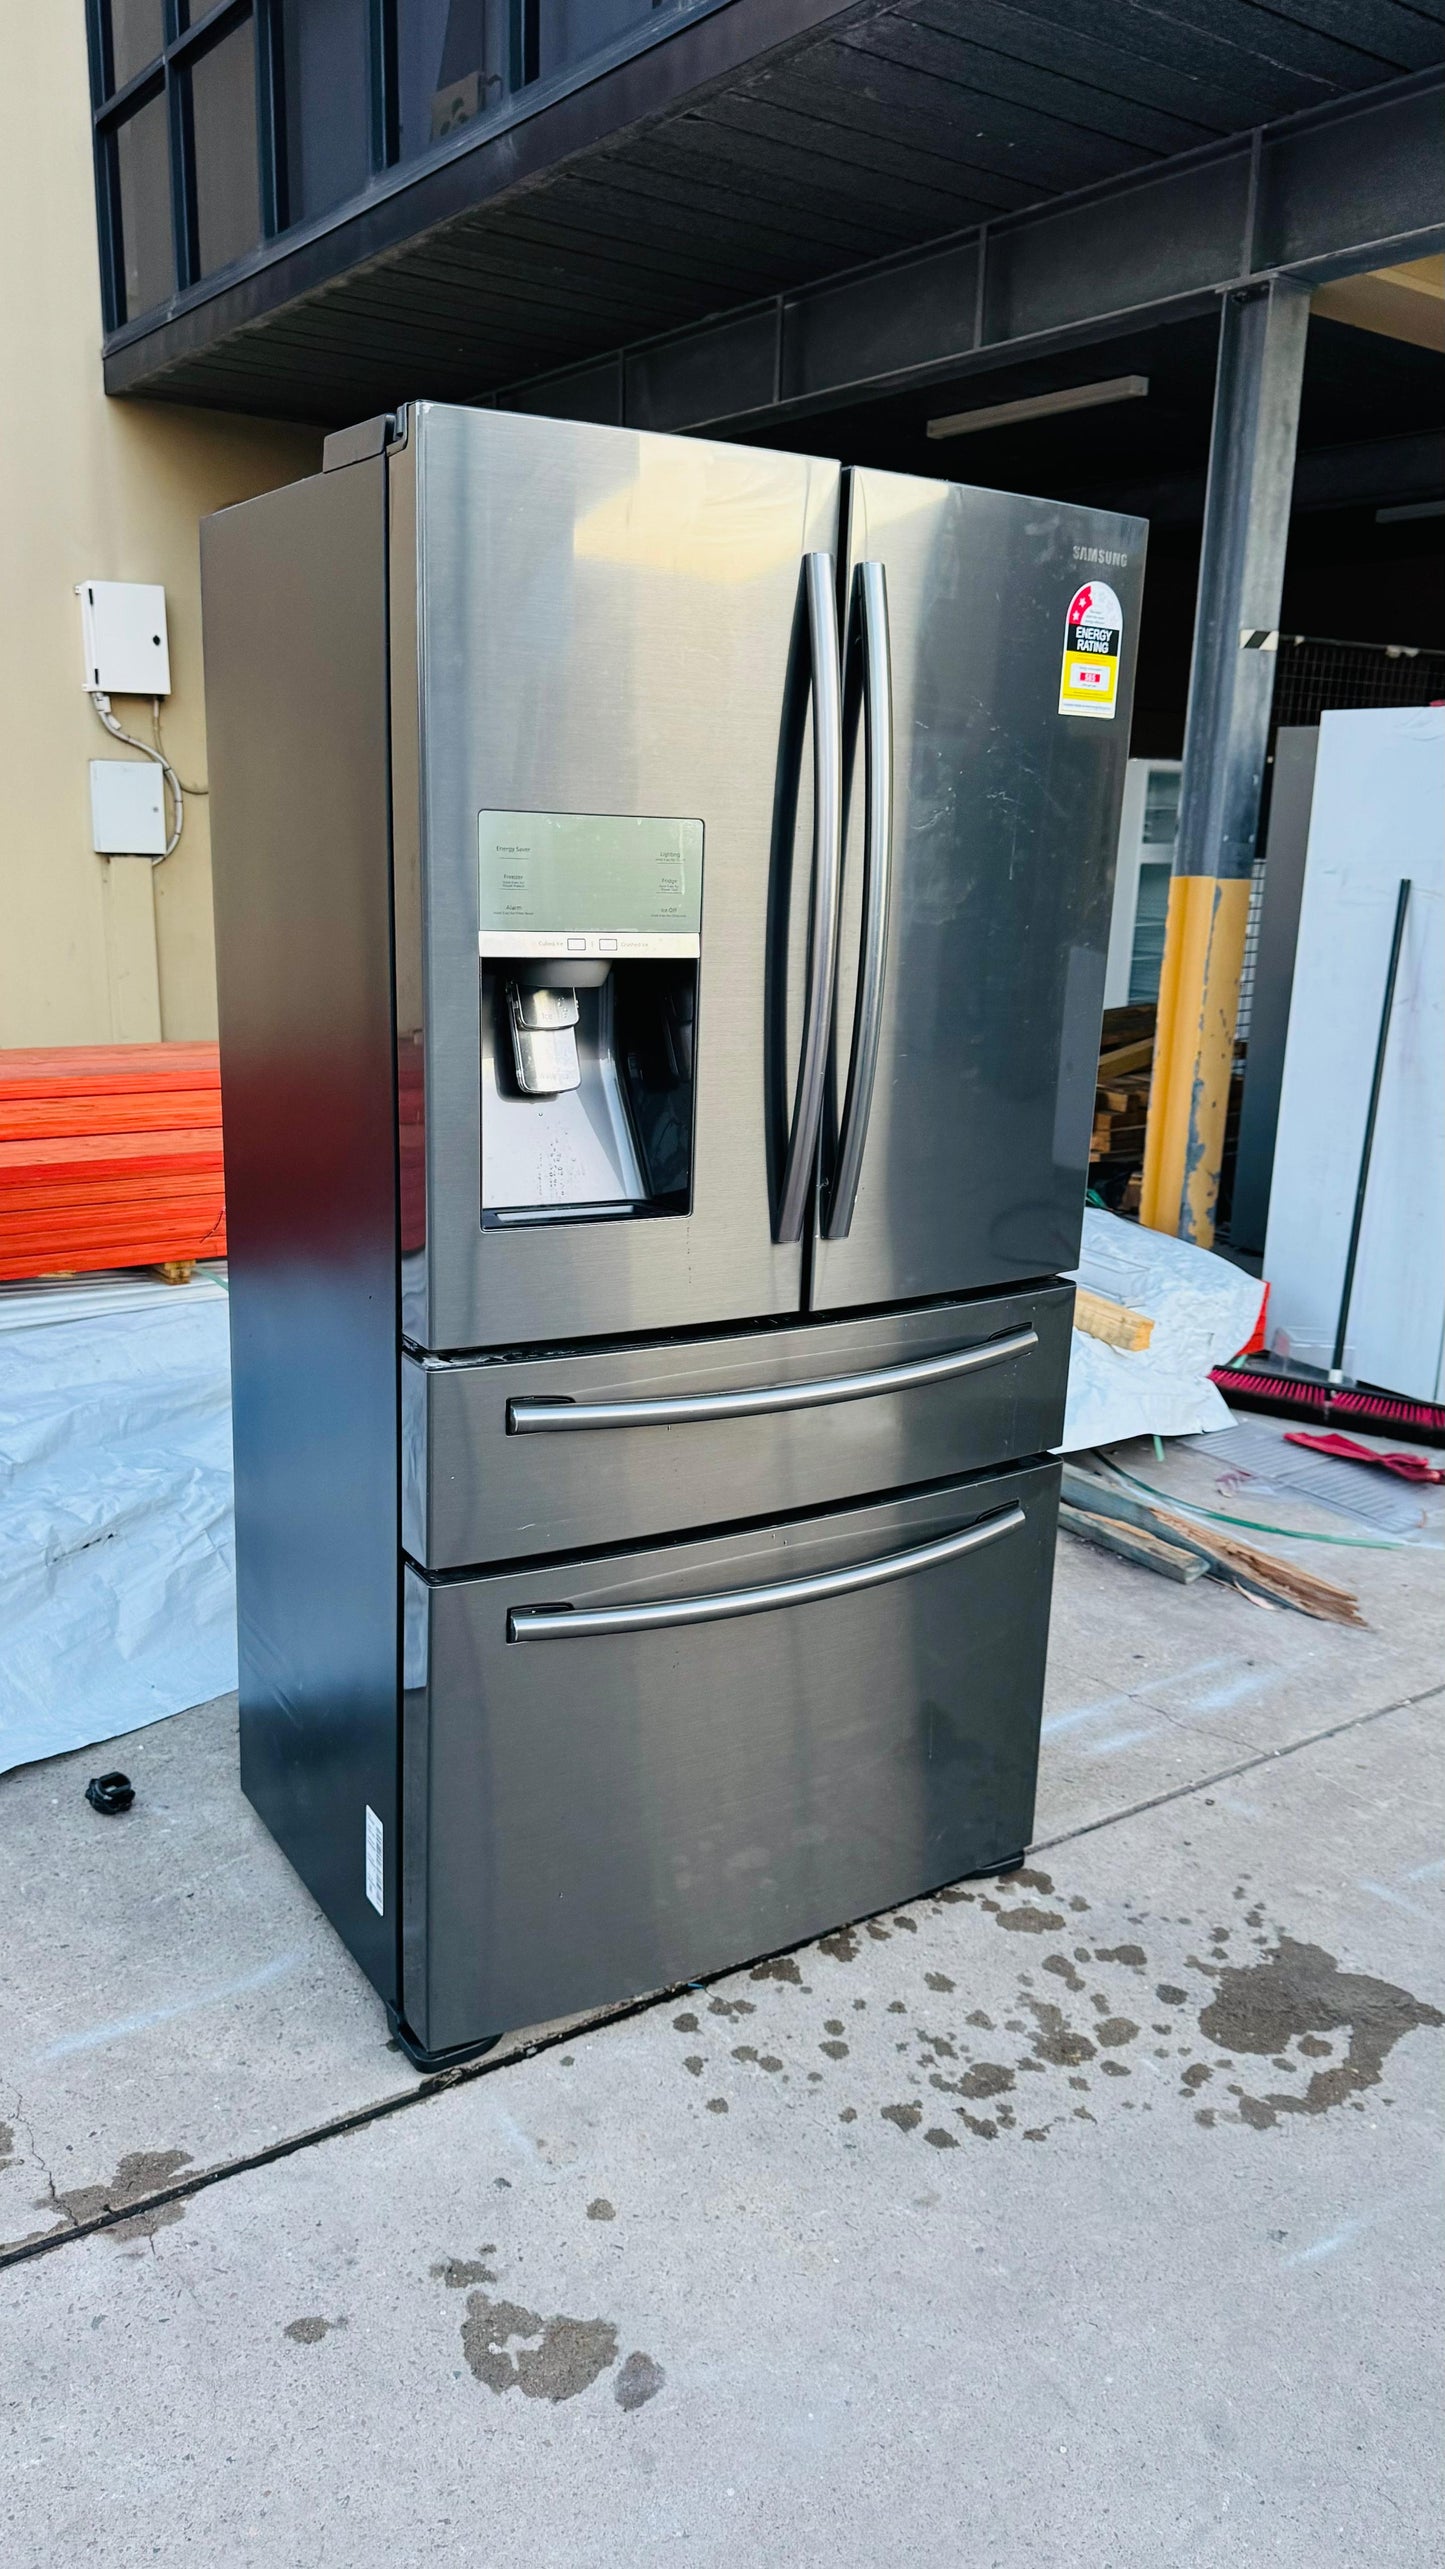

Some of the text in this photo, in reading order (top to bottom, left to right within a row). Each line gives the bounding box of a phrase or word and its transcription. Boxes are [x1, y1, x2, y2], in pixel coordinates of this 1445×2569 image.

[1072, 545, 1128, 568] SAMSUNG
[1075, 626, 1113, 642] ENERGY
[1076, 639, 1110, 654] RATING
